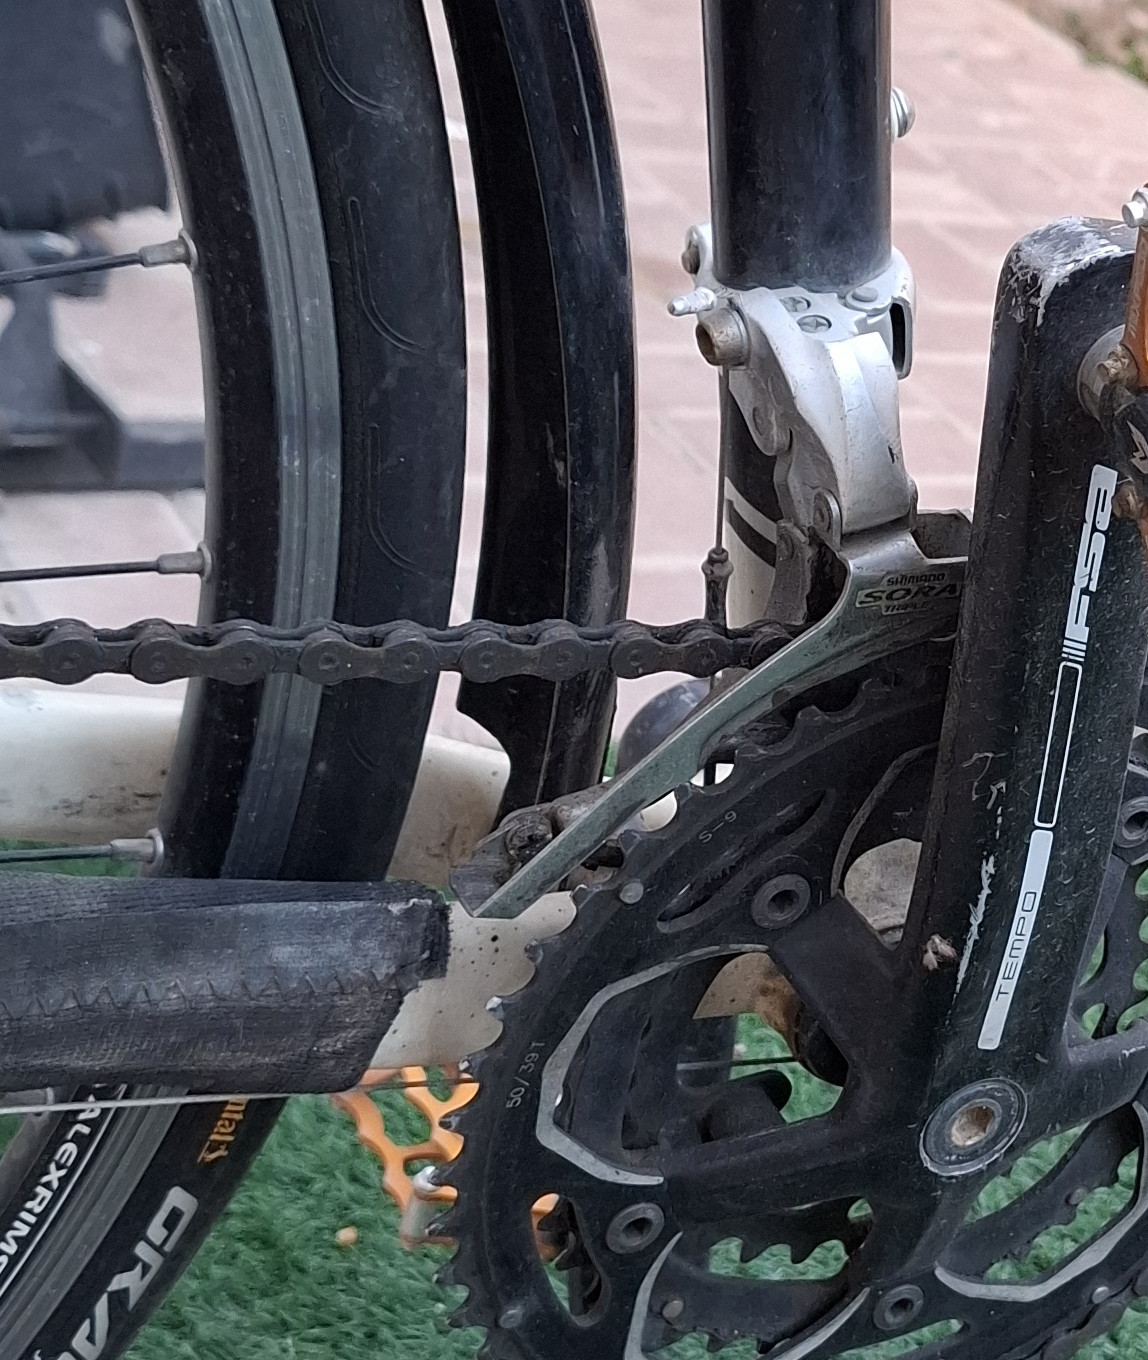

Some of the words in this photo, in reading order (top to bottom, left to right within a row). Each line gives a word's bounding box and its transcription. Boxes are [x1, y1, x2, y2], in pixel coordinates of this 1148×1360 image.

[858, 583, 959, 606] SORA
[886, 572, 946, 587] SHIMANO
[996, 890, 1036, 1001] TEMPO
[0, 1094, 101, 1275] ALEXRIM
